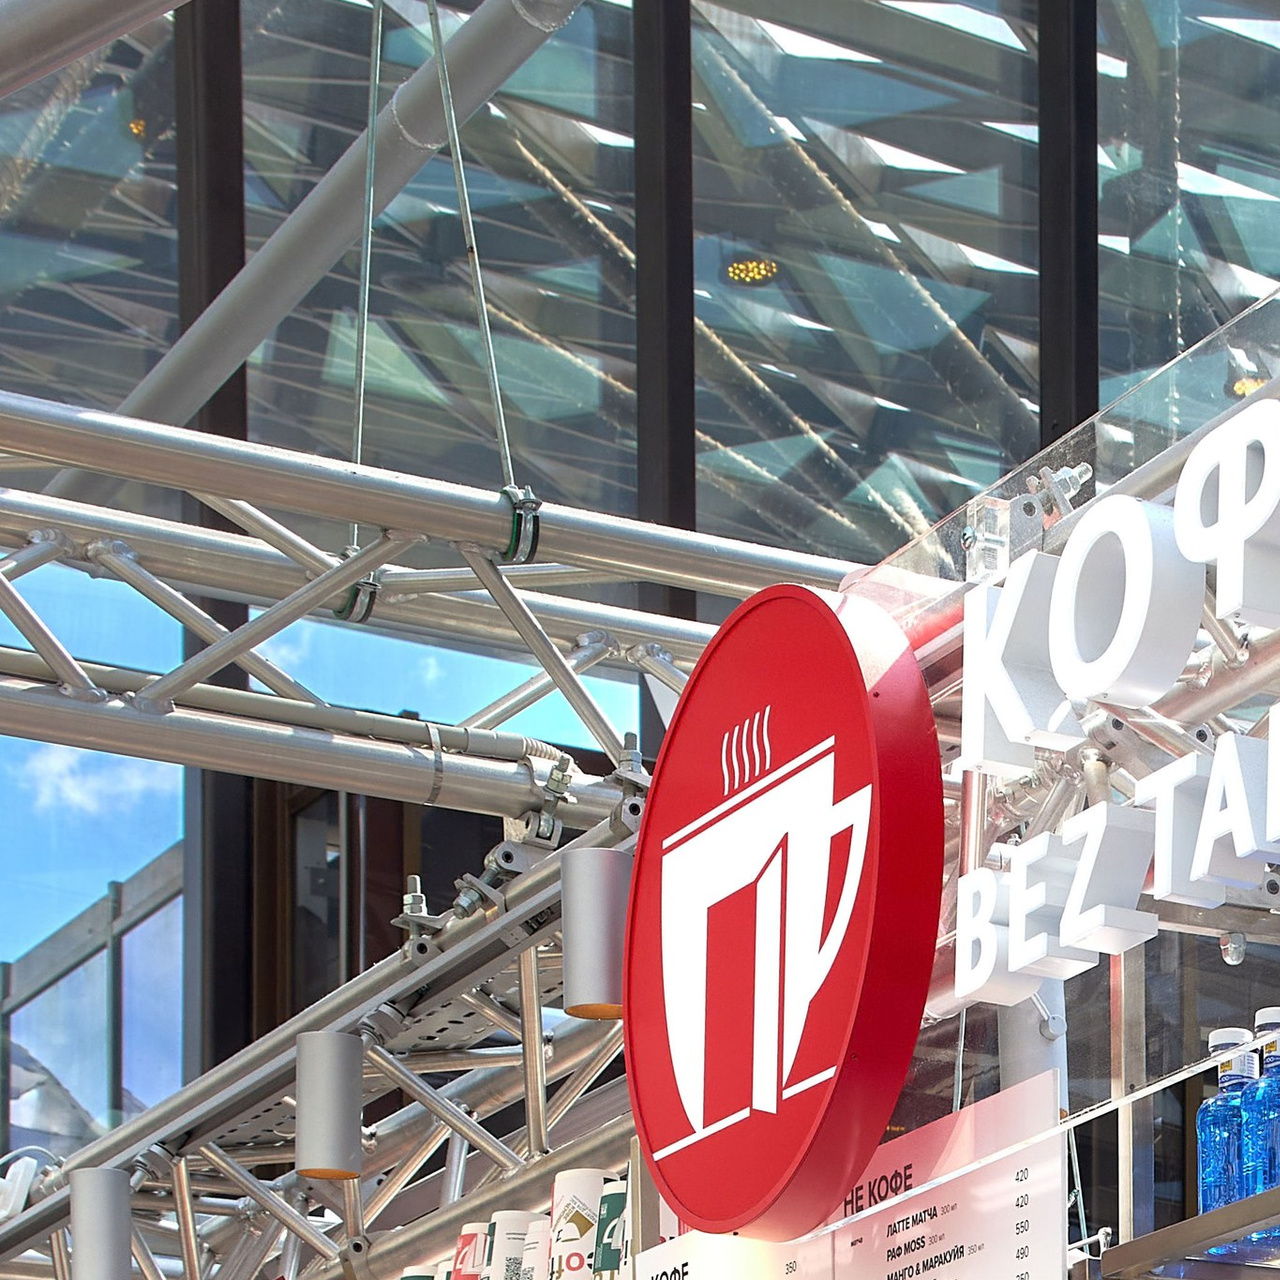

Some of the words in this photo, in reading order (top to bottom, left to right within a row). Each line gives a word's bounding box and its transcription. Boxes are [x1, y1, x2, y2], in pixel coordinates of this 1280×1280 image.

[955, 800, 1130, 1001] BEZ
[1015, 1167, 1029, 1183] 420
[843, 1184, 863, 1218] НЕ
[868, 1164, 913, 1208] КОФЕ
[1015, 1193, 1029, 1209] 420
[887, 1217, 910, 1238] ЛАТТЕ
[911, 1206, 938, 1227] МАТЧА
[1015, 1219, 1030, 1236] 550
[887, 1247, 902, 1262] РАФ
[904, 1236, 926, 1256] MOSS
[922, 1244, 965, 1273] МАРАКУЙЯ
[1015, 1245, 1030, 1261] 490
